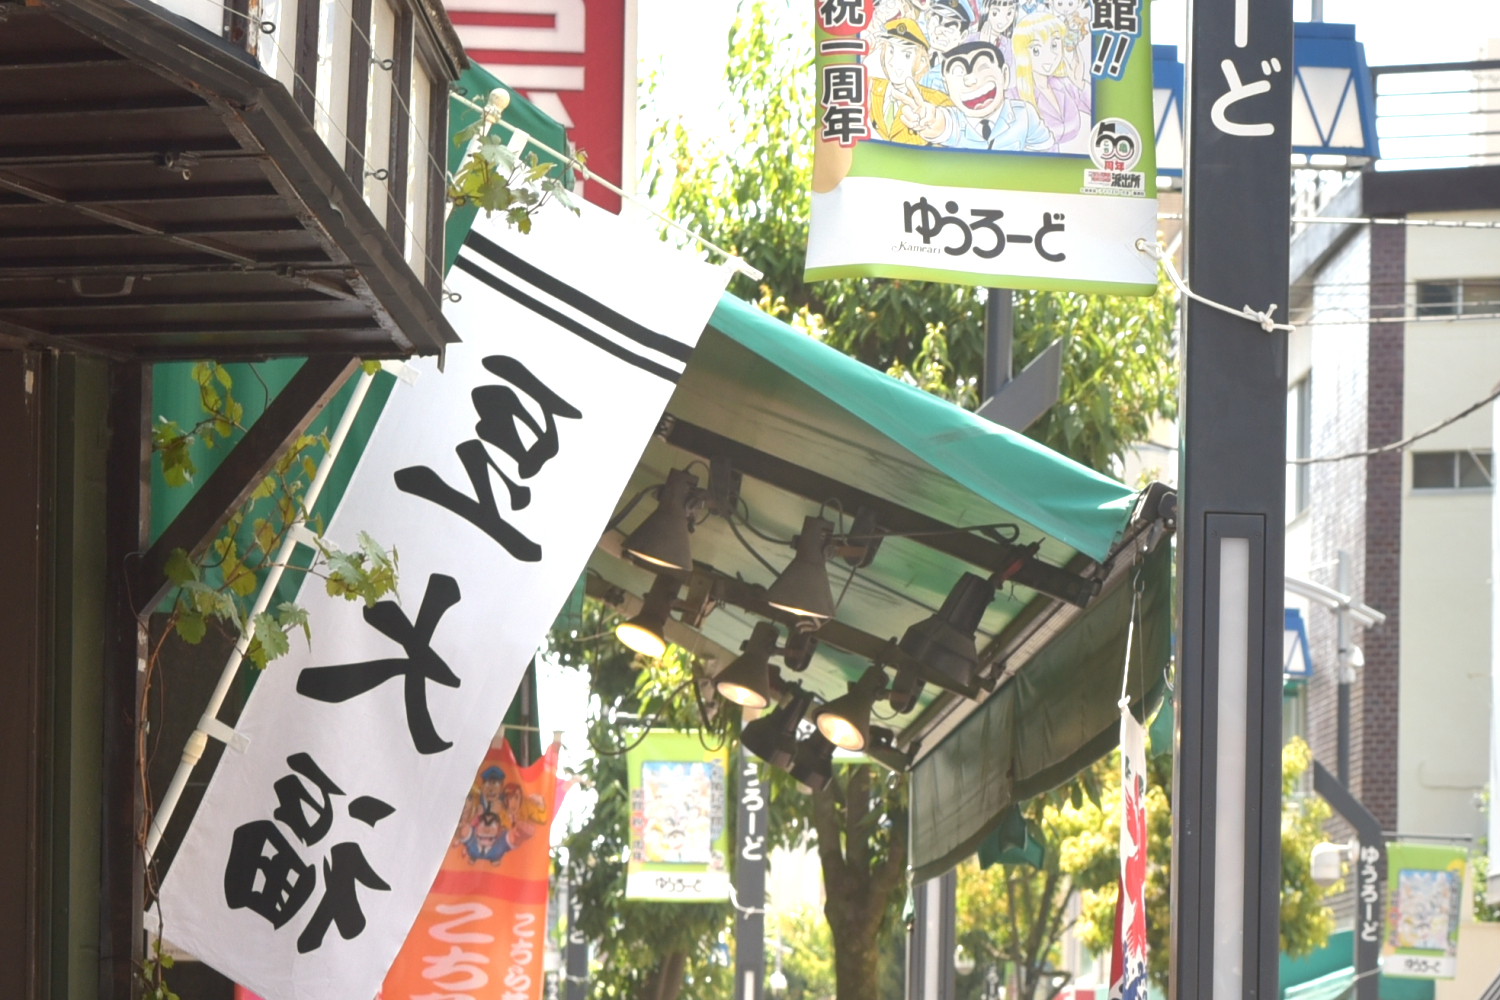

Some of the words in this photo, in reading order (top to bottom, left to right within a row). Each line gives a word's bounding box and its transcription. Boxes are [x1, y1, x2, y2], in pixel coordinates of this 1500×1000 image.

[819, 0, 869, 143] 祝一周年
[1111, 172, 1141, 188] 派出所
[891, 240, 941, 255] Kameari
[904, 197, 1066, 262] ゆうろーど
[1360, 846, 1380, 941] ゆうろーど
